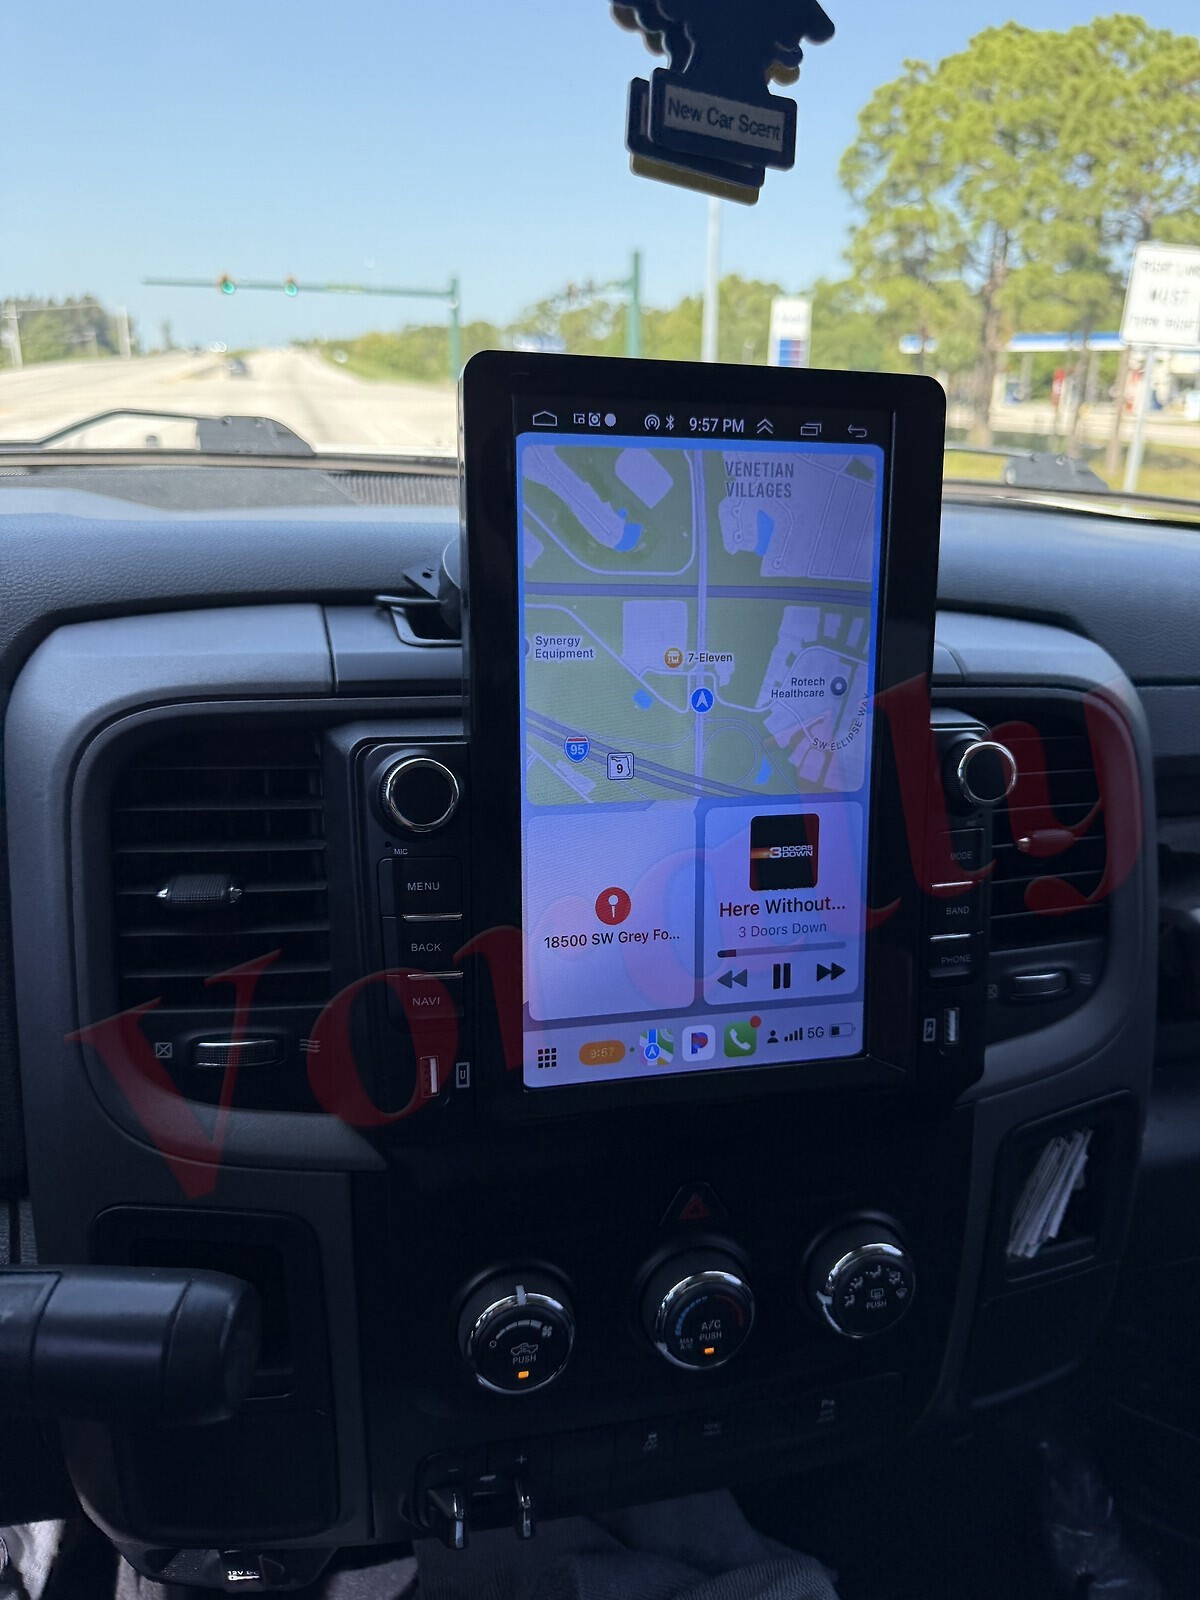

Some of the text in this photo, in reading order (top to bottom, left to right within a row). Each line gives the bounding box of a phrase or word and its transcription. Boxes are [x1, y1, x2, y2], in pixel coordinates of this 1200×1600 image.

[668, 97, 782, 141] New Car Scent
[689, 417, 744, 433] 9:57 PM
[725, 461, 794, 479] VENETIAN
[725, 482, 792, 499] VILLAGES
[535, 636, 581, 647] Synergy
[535, 649, 594, 660] Equipment
[688, 653, 733, 663] 7-Eleven
[791, 677, 825, 686] Rotech
[771, 689, 825, 698] Healthcare
[812, 738, 828, 750] SW
[830, 721, 863, 751] ELLIPSE
[570, 744, 585, 756] 95
[616, 764, 624, 774] 9
[769, 847, 781, 859] 3
[407, 882, 440, 891] MENU
[720, 897, 846, 917] Here Without...
[946, 906, 970, 915] BAND
[738, 923, 827, 938] 3 Doors Down
[544, 929, 680, 949] 18500 SW Grey Fo...
[411, 943, 442, 952] BACK
[941, 954, 972, 964] PHONE
[412, 997, 440, 1006] NAVI
[807, 1027, 825, 1038] 5G
[866, 1299, 887, 1310] PUSH
[701, 1319, 721, 1331] A/C
[699, 1330, 722, 1341] PUSH
[512, 1354, 537, 1364] PUSH
